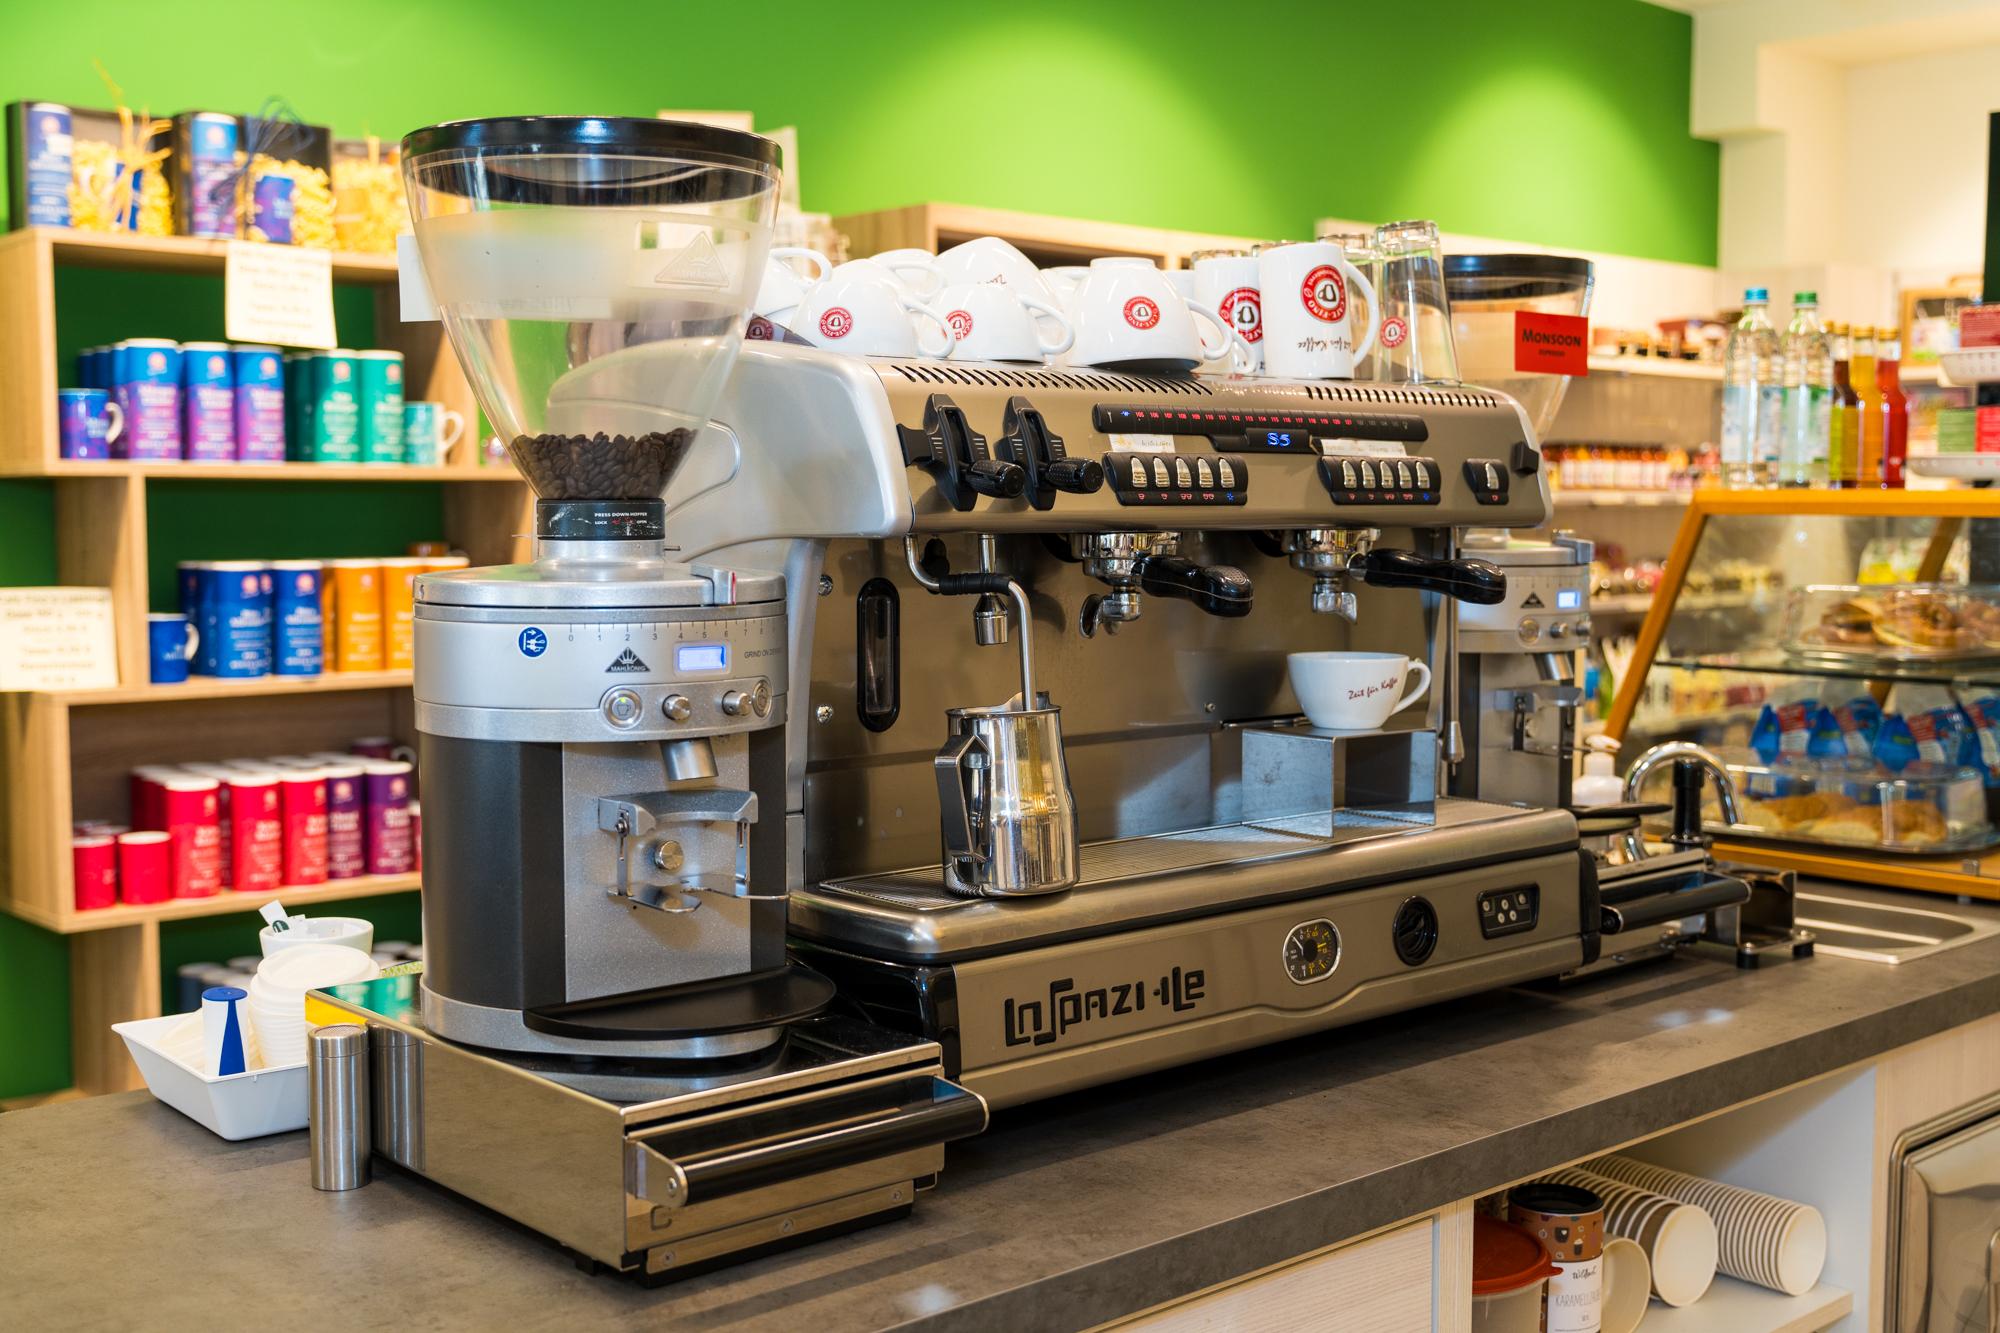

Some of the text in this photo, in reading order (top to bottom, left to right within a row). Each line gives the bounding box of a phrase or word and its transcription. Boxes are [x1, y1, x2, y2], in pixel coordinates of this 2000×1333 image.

[1522, 328, 1581, 348] MONSOON
[625, 633, 630, 641] 2
[744, 650, 760, 659] GRIND
[1348, 689, 1364, 700] Zeit
[1367, 686, 1379, 698] für
